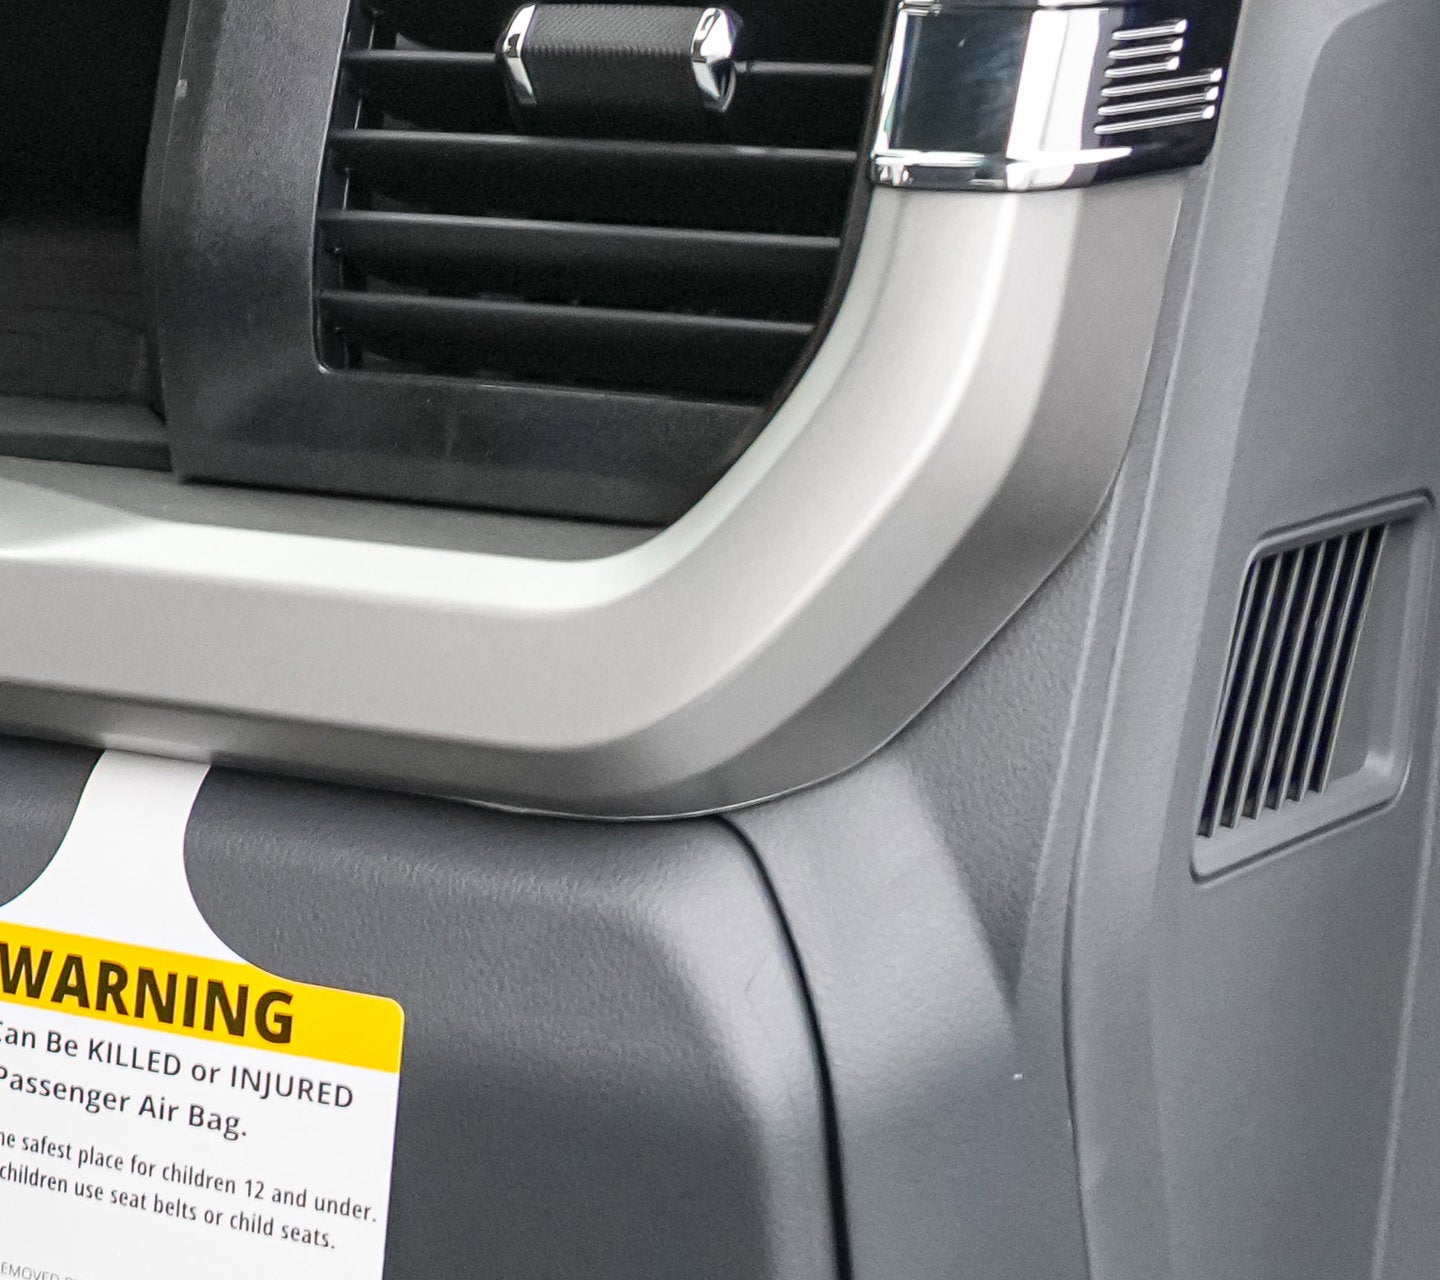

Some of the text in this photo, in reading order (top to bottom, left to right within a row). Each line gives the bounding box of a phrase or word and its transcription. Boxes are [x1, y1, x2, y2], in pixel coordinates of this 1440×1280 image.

[46, 1030, 78, 1058] Be
[88, 1038, 181, 1077] KILLED
[191, 1063, 221, 1085] or
[231, 1065, 354, 1109] INJURED
[138, 1094, 179, 1122] Air
[188, 1103, 246, 1141] Bag.
[0, 1161, 67, 1194] children
[75, 1181, 104, 1201] use
[110, 1189, 147, 1211] seat
[153, 1193, 197, 1221] belts
[204, 1209, 223, 1226] or
[230, 1211, 274, 1236] child
[281, 1225, 335, 1249] seats.
[22, 1135, 72, 1161] safest
[78, 1145, 123, 1172] place
[131, 1154, 156, 1178] for
[162, 1162, 235, 1194] children
[245, 1179, 264, 1200] 12
[272, 1188, 307, 1208] and
[315, 1196, 376, 1222] under.
